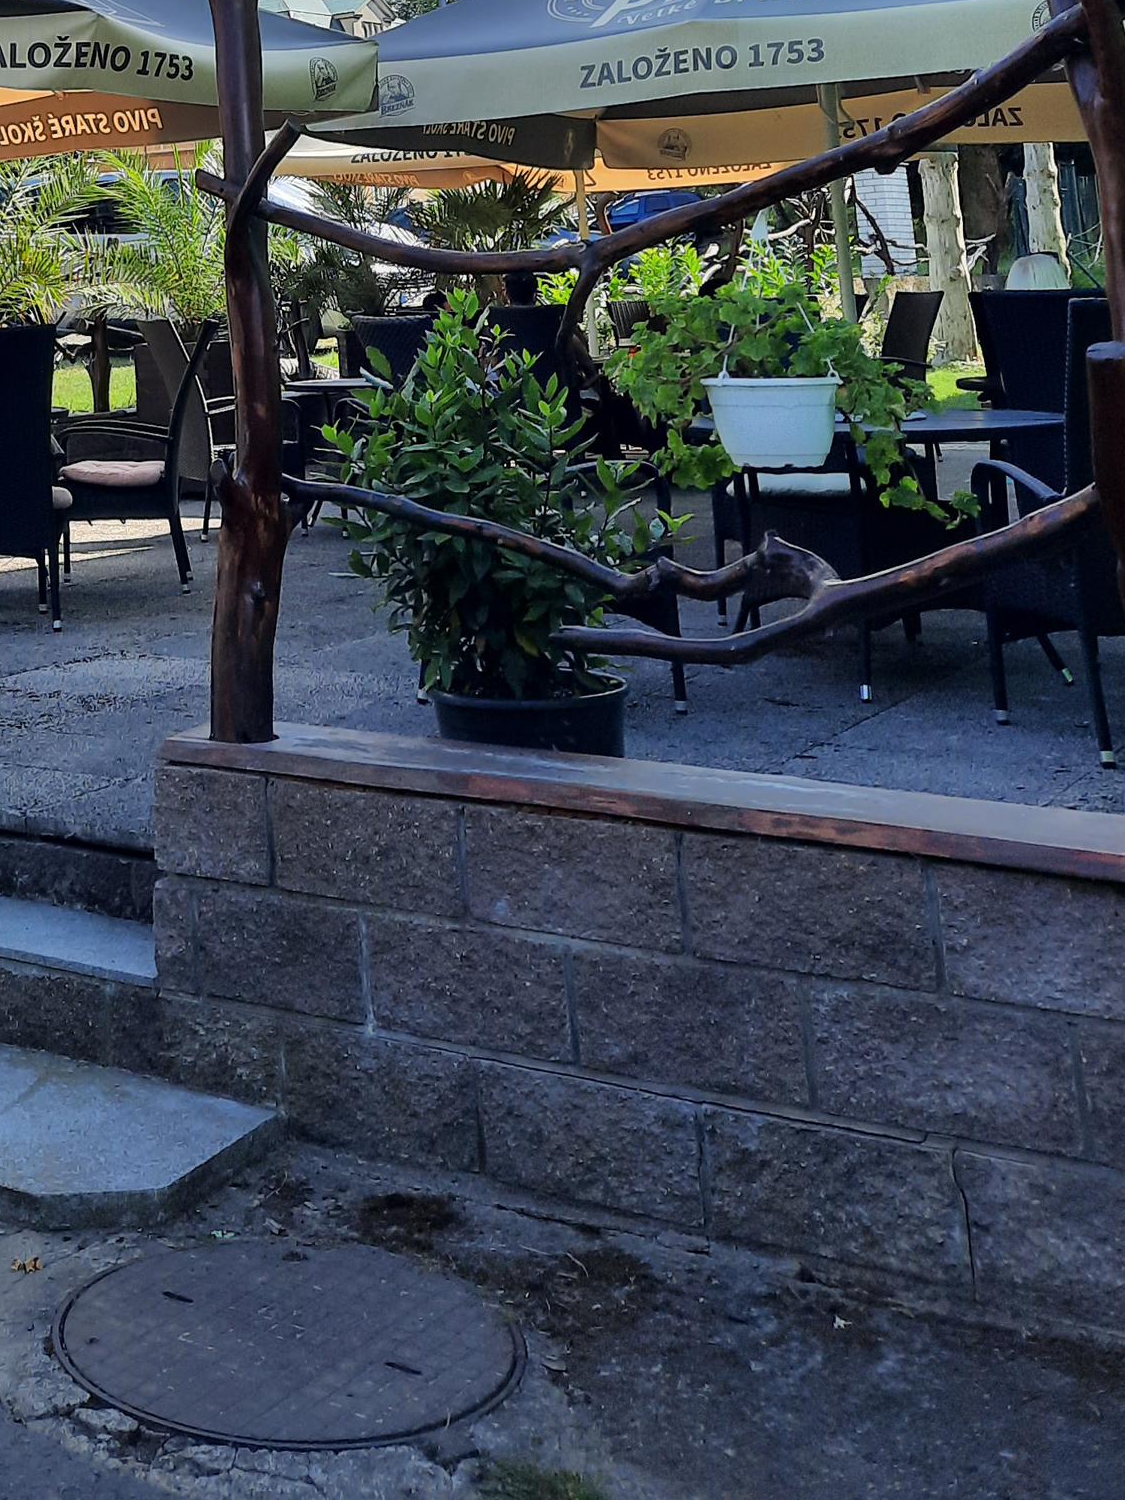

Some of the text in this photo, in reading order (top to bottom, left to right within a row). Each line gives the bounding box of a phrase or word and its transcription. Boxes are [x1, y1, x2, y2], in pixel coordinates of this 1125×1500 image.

[136, 50, 194, 81] 1753
[579, 38, 826, 89] ZALOŽENO 1753
